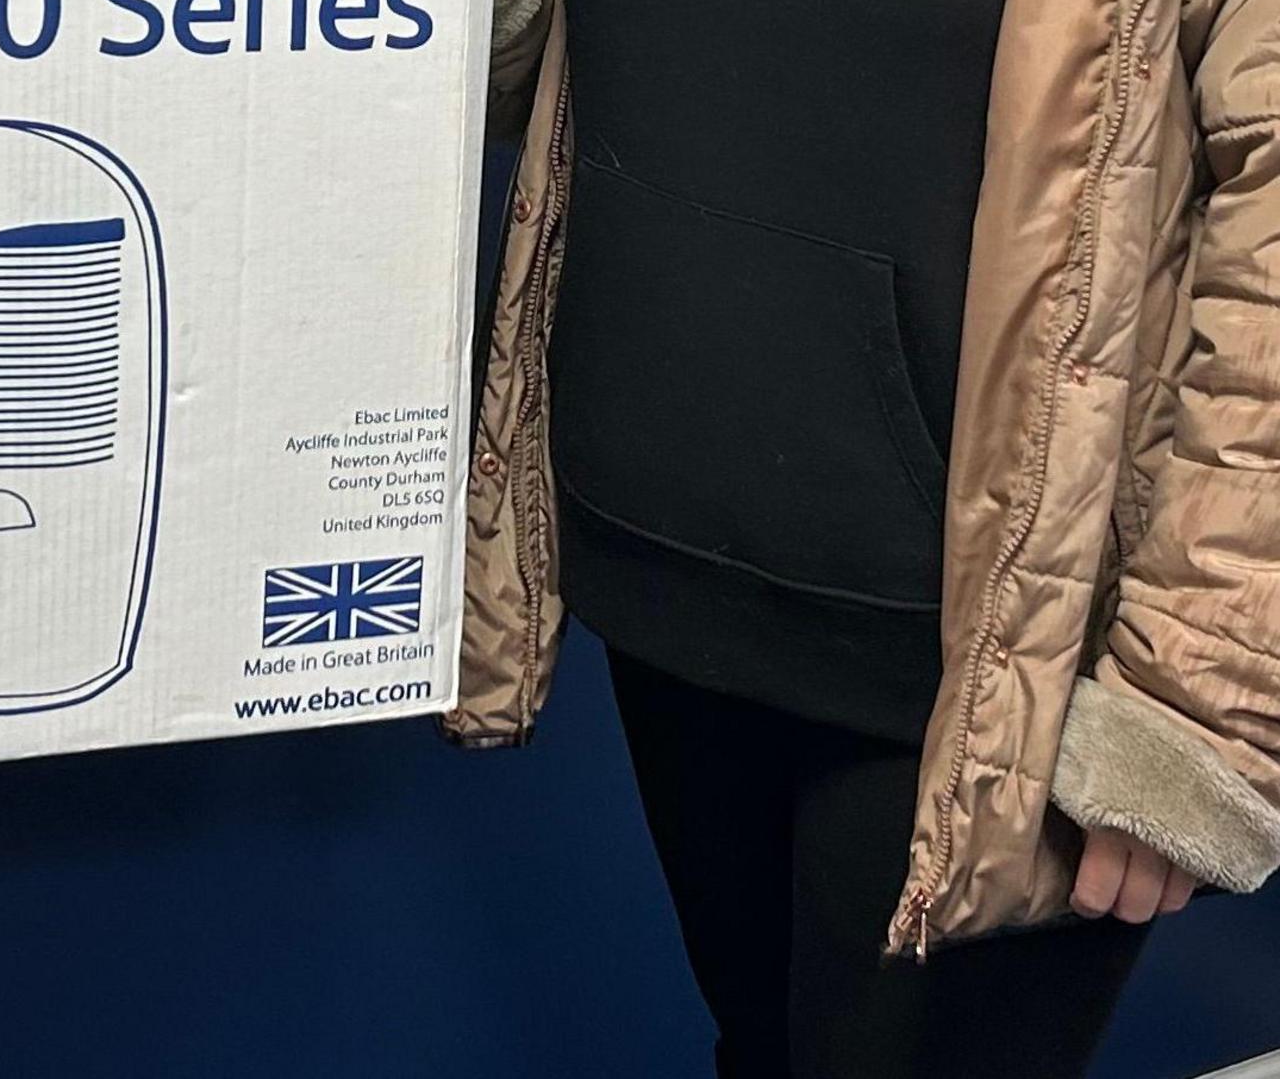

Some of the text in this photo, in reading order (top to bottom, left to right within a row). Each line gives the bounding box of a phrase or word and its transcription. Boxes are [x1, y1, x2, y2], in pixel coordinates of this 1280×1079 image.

[355, 405, 449, 424] Ebac Limited
[286, 426, 448, 453] Aycliffe Industrial Park
[331, 448, 447, 469] Newton Aycliffe
[328, 470, 445, 491] County Durham
[383, 489, 444, 507] DL5 6SQ
[323, 512, 442, 533] United Kingdom
[244, 643, 434, 677] Made in Great Britain
[235, 681, 431, 718] www.ebac.com
